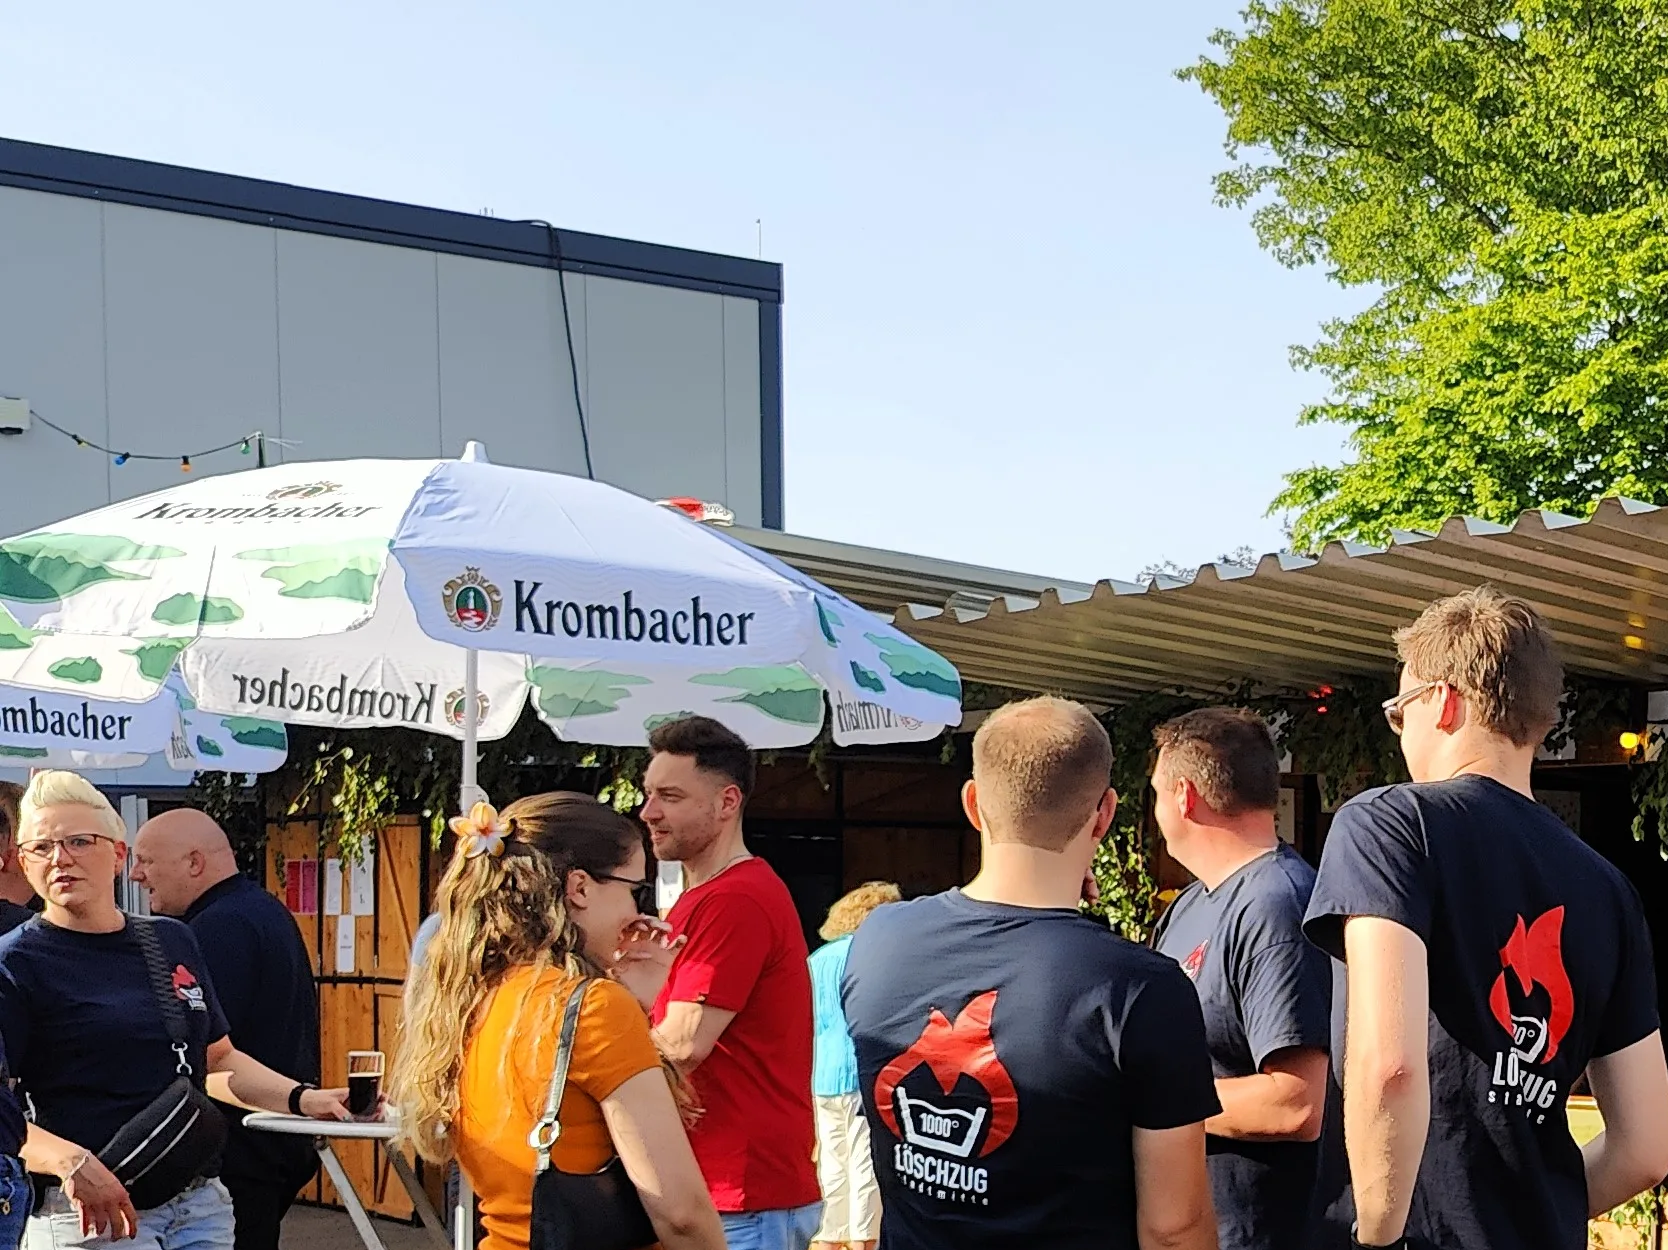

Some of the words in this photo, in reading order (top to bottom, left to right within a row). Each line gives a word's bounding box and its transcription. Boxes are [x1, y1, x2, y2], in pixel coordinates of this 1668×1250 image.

[132, 502, 384, 519] Krombacher
[513, 579, 756, 647] Krombacher
[0, 696, 133, 741] mbacher
[893, 1142, 988, 1193] LÖSCHZUG
[897, 1173, 989, 1206] tadtmitte
